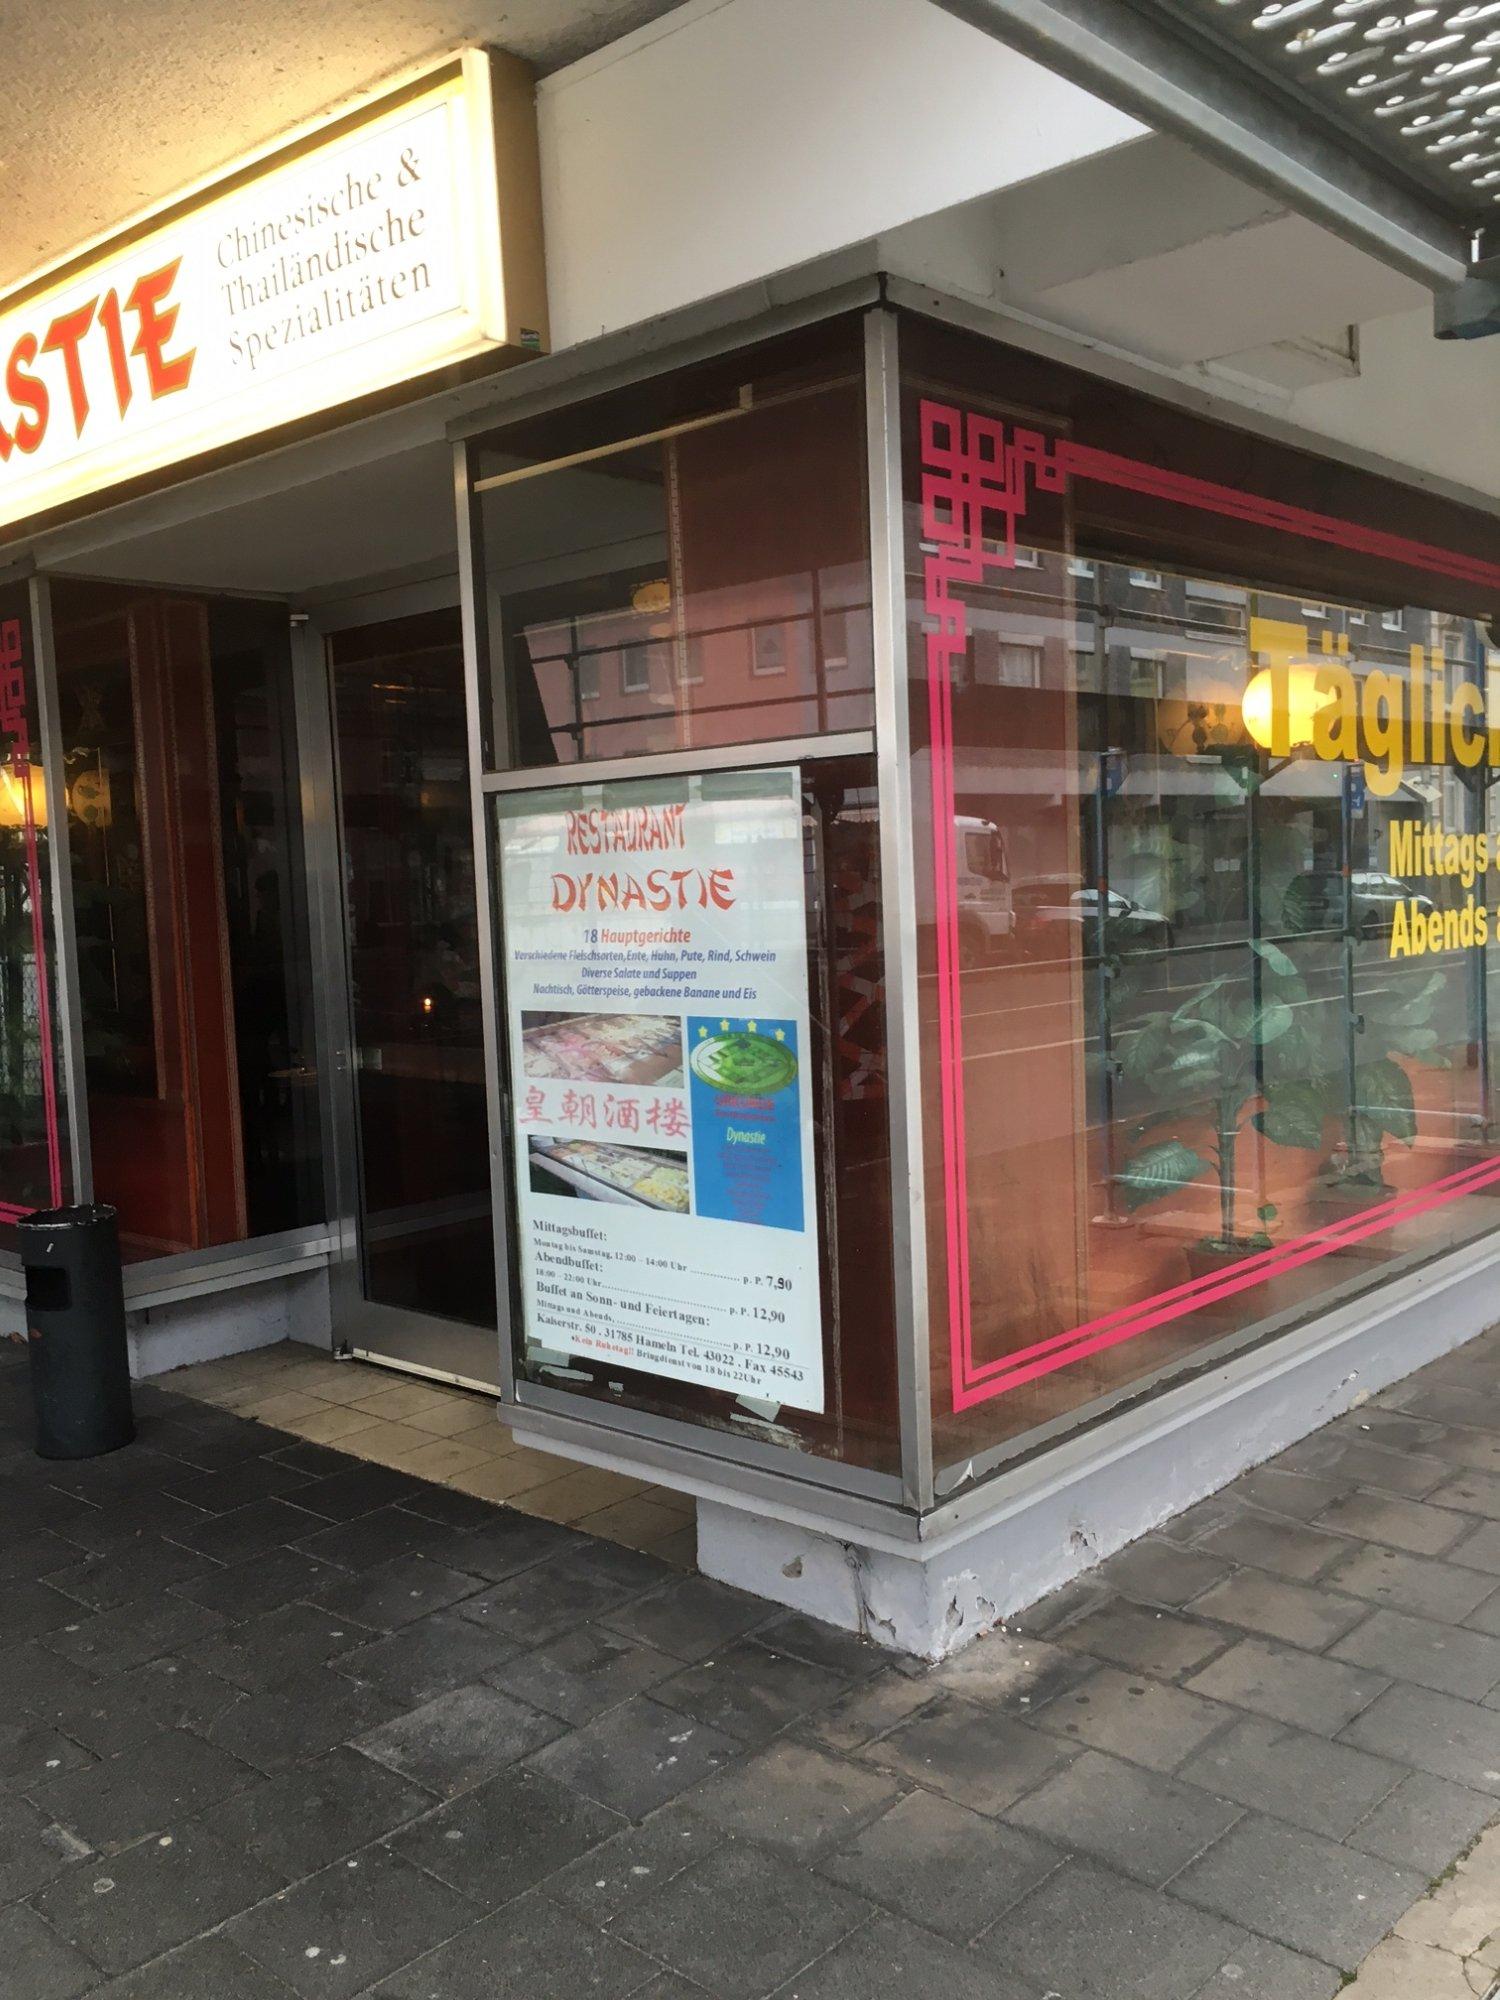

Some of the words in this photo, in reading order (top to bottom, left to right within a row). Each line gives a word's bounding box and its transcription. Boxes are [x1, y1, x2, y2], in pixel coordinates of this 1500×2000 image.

[217, 172, 382, 269] Chinesische
[396, 147, 422, 188] &
[220, 208, 425, 316] Thailändische
[229, 261, 431, 371] Spezialitäten
[0, 254, 197, 462] STIE
[565, 801, 689, 855] RESTAURANT
[1389, 819, 1489, 888] Mittags
[551, 868, 737, 912] DYNASTIE
[583, 929, 599, 944] 18
[601, 927, 692, 947] Hauptgerichte
[1389, 893, 1489, 959] Abends
[514, 949, 567, 961] Verschiedene
[651, 949, 679, 962] Huhn,
[680, 949, 705, 963] Pute,
[707, 949, 733, 963] Rind,
[735, 949, 777, 962] Schwein
[581, 966, 613, 979] Diverse
[614, 967, 642, 979] Salate
[643, 968, 661, 980] und
[662, 968, 698, 982] Suppen
[532, 983, 575, 996] Nachtisch,
[576, 984, 632, 998] Götterspeise,
[633, 985, 682, 999] gebackene
[683, 986, 721, 998] Banane
[722, 987, 742, 999] und
[743, 987, 757, 1000] Eis
[726, 1126, 767, 1145] Dynastie
[533, 1219, 608, 1242] Mittagsbuffet:
[533, 1237, 563, 1251] Montag
[564, 1242, 577, 1252] bis
[615, 1252, 637, 1263] 12:00
[646, 1257, 668, 1269] 14:00
[670, 1261, 687, 1272] Uhr
[535, 1252, 604, 1273] Abendbuffet:
[536, 1268, 556, 1278] 18:00
[564, 1273, 585, 1284] 22:00
[753, 1307, 786, 1324] 12,90
[537, 1281, 567, 1297] Buffet
[570, 1290, 584, 1300] an
[586, 1291, 618, 1307] Sonn-
[620, 1300, 642, 1313] und
[645, 1303, 711, 1326] Feiertagen:
[537, 1299, 564, 1312] Mittags
[566, 1306, 581, 1316] und
[757, 1342, 790, 1360] 12,90
[537, 1313, 583, 1332] Kaiserstr.
[585, 1324, 597, 1335] 50
[604, 1328, 634, 1342] 31785
[636, 1334, 677, 1353] Hameln
[681, 1344, 700, 1359] Tel.
[703, 1350, 735, 1366] 43022
[745, 1358, 767, 1373] Fax
[770, 1366, 804, 1382] 45543
[575, 1334, 593, 1346] Kein
[636, 1348, 686, 1367] Bringdienst
[687, 1361, 703, 1372] von
[705, 1364, 716, 1374] 18
[718, 1367, 731, 1379] bis
